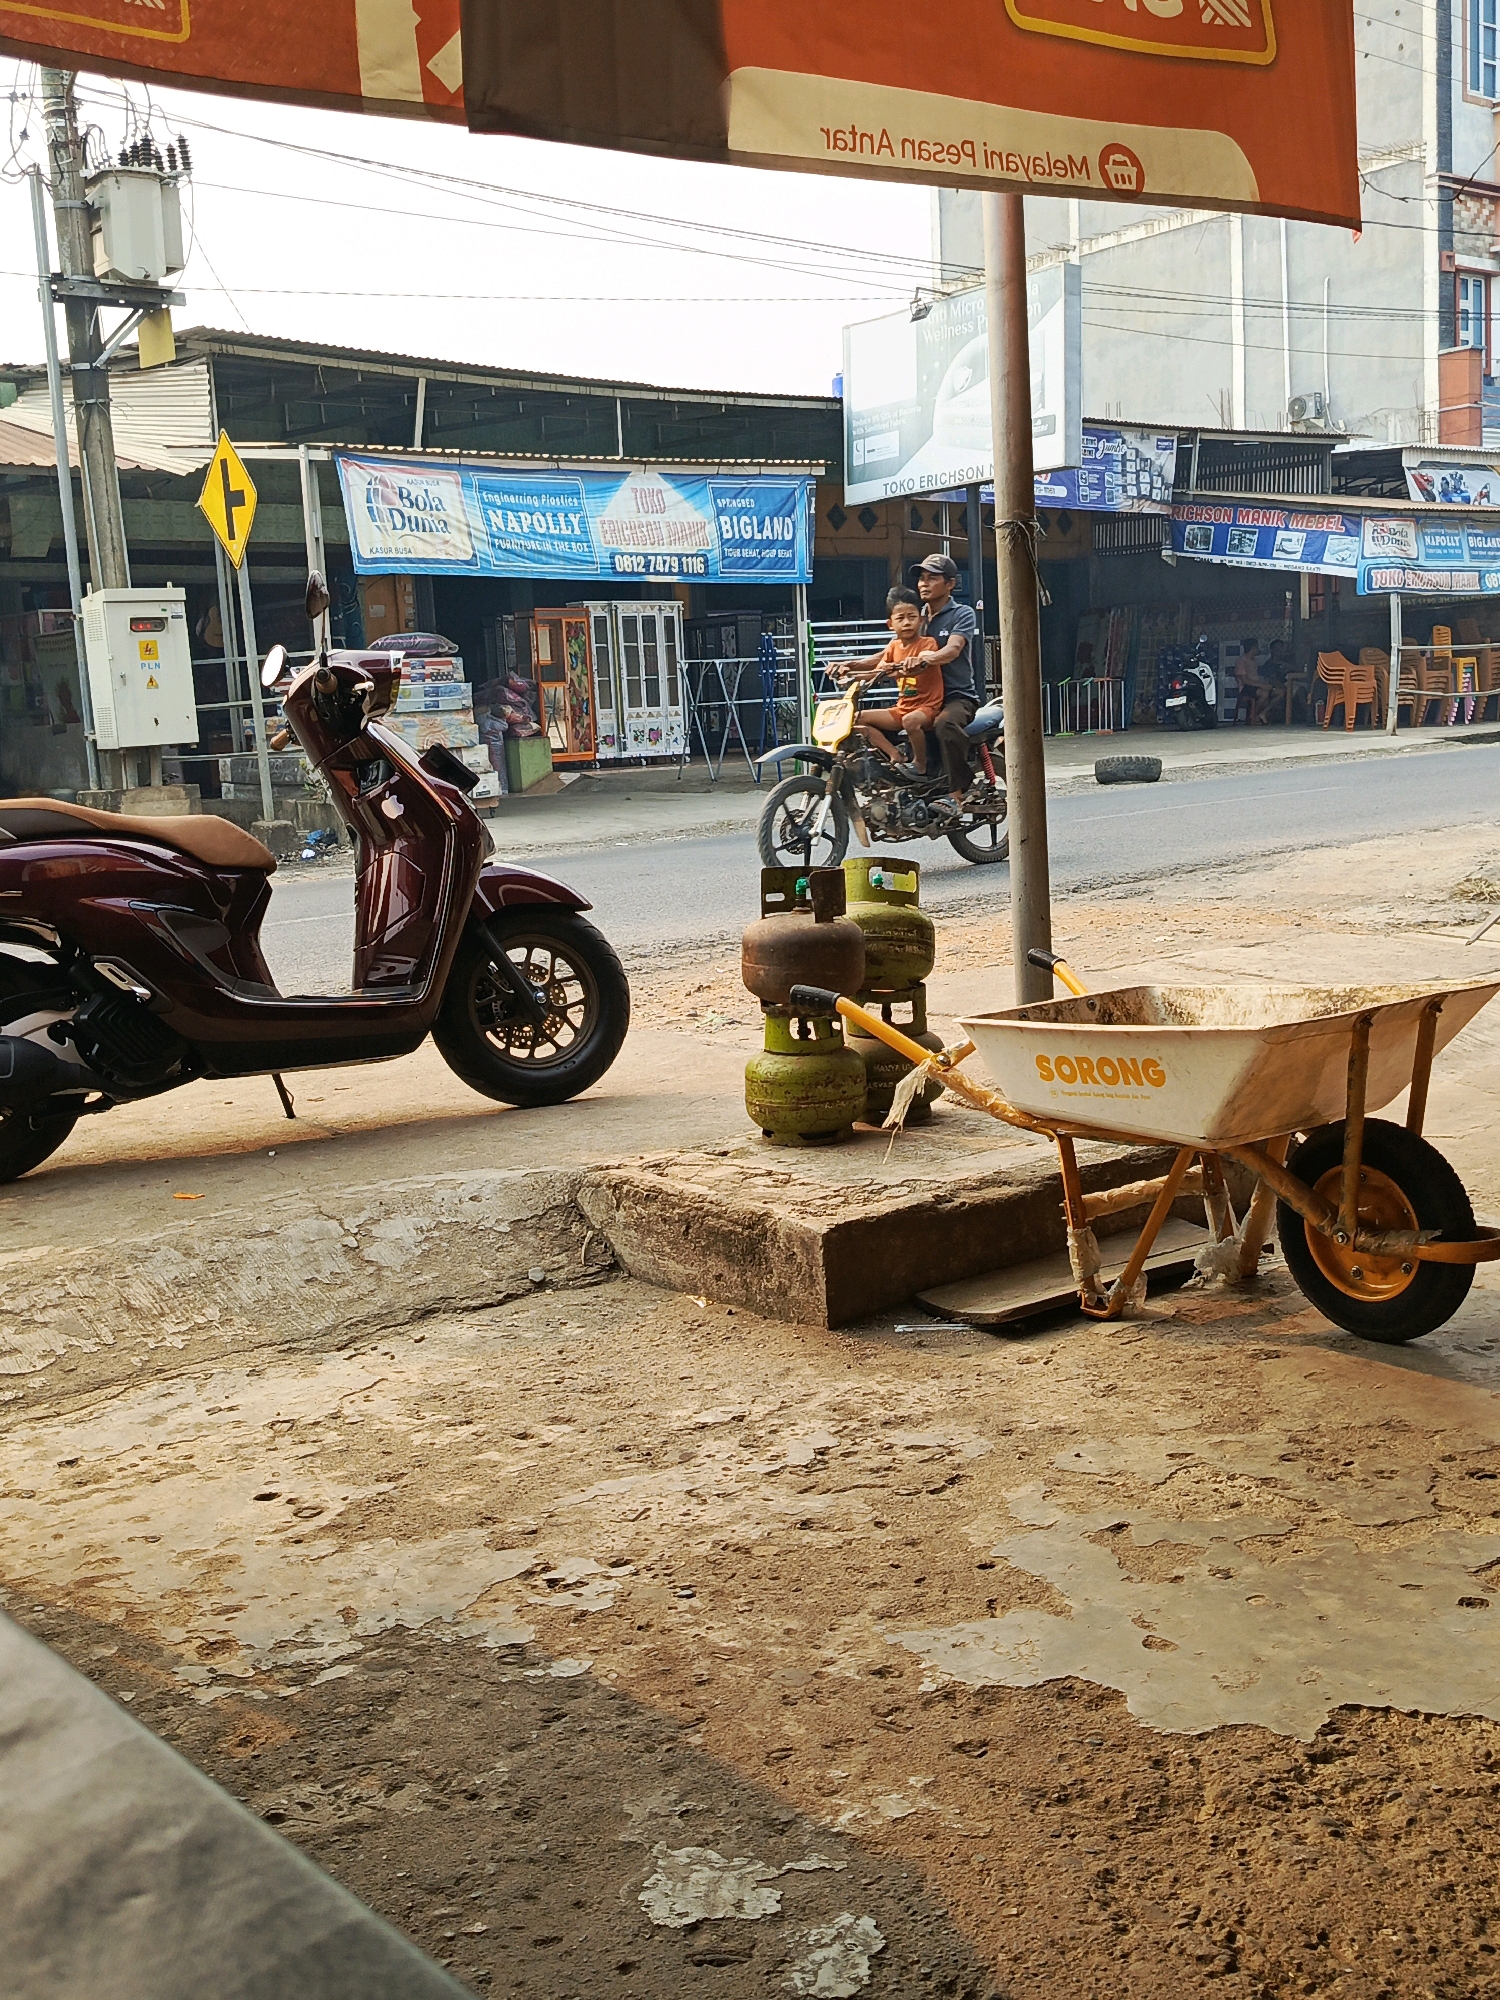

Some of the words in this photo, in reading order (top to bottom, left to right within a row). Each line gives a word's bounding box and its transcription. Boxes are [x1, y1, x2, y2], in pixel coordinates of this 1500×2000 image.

[950, 298, 985, 319] Micro
[922, 320, 974, 344] Wellness
[883, 477, 915, 496] TOKO
[919, 464, 984, 488] ERICHSON
[397, 485, 447, 512] Bola
[631, 487, 667, 515] TOKO
[387, 507, 452, 534] Dunia
[487, 509, 582, 535] NAPOLLY
[719, 515, 794, 541] BIGLAND
[1167, 504, 1233, 524] RICHSON
[1237, 507, 1287, 528] MANIK
[1290, 512, 1346, 533] MEBEL
[494, 538, 542, 551] FURNITURE
[555, 541, 569, 552] THE
[571, 542, 589, 553] BOX
[600, 519, 665, 547] ERICHSON
[1424, 535, 1460, 546] NAPOLLY
[369, 547, 393, 555] KASUR
[394, 547, 413, 555] BUSA
[614, 554, 646, 573] 0812
[648, 555, 679, 573] 7479
[681, 556, 705, 574] 1116
[1372, 569, 1404, 588] TOKO
[140, 662, 161, 670] PLN
[1035, 1054, 1167, 1088] SORONG
